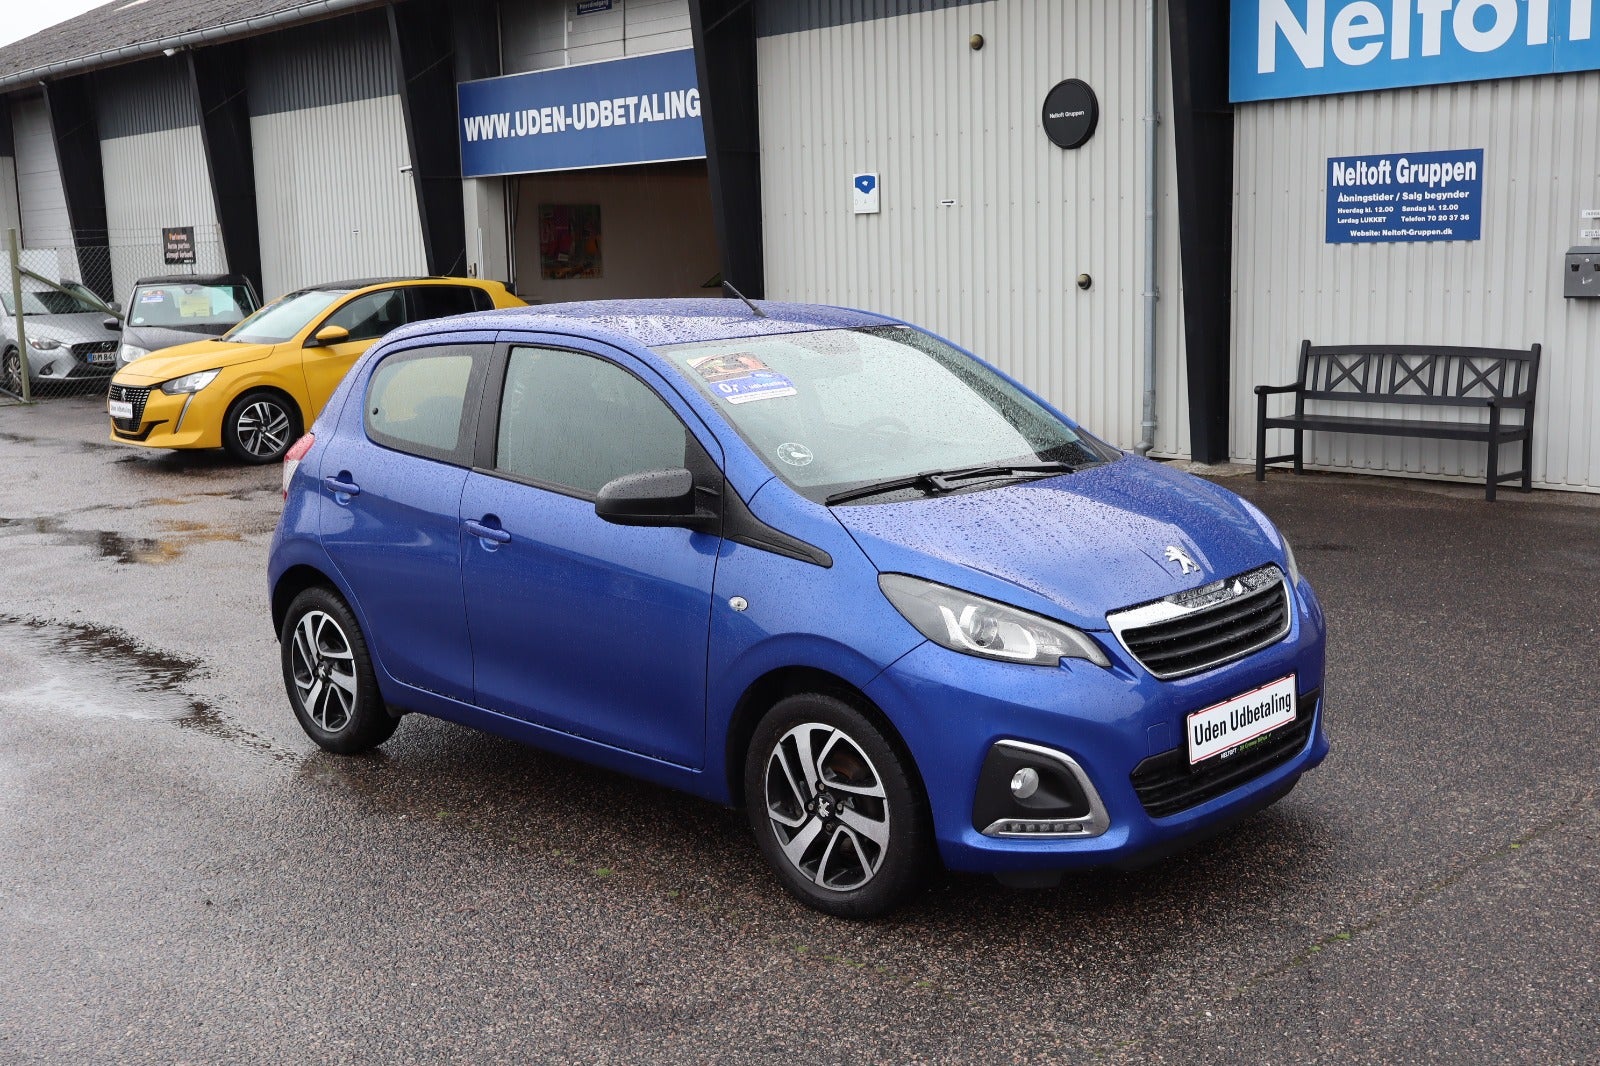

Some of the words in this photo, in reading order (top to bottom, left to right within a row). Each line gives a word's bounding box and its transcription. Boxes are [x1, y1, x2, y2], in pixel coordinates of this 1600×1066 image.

[463, 88, 701, 142] WWW.UDEN-UDBETALING
[1332, 159, 1392, 187] Neltoft
[1396, 157, 1477, 188] Gruppen
[1337, 192, 1394, 203] Åbningstider
[1402, 192, 1423, 201] Salg
[1424, 190, 1470, 200] begynder
[1401, 215, 1426, 223] Telefon
[1350, 229, 1381, 237] Website:
[1382, 228, 1453, 236] Neltoft-Gruppen.dk
[1194, 719, 1227, 746] Uden
[1230, 692, 1292, 731] Udbetaling
